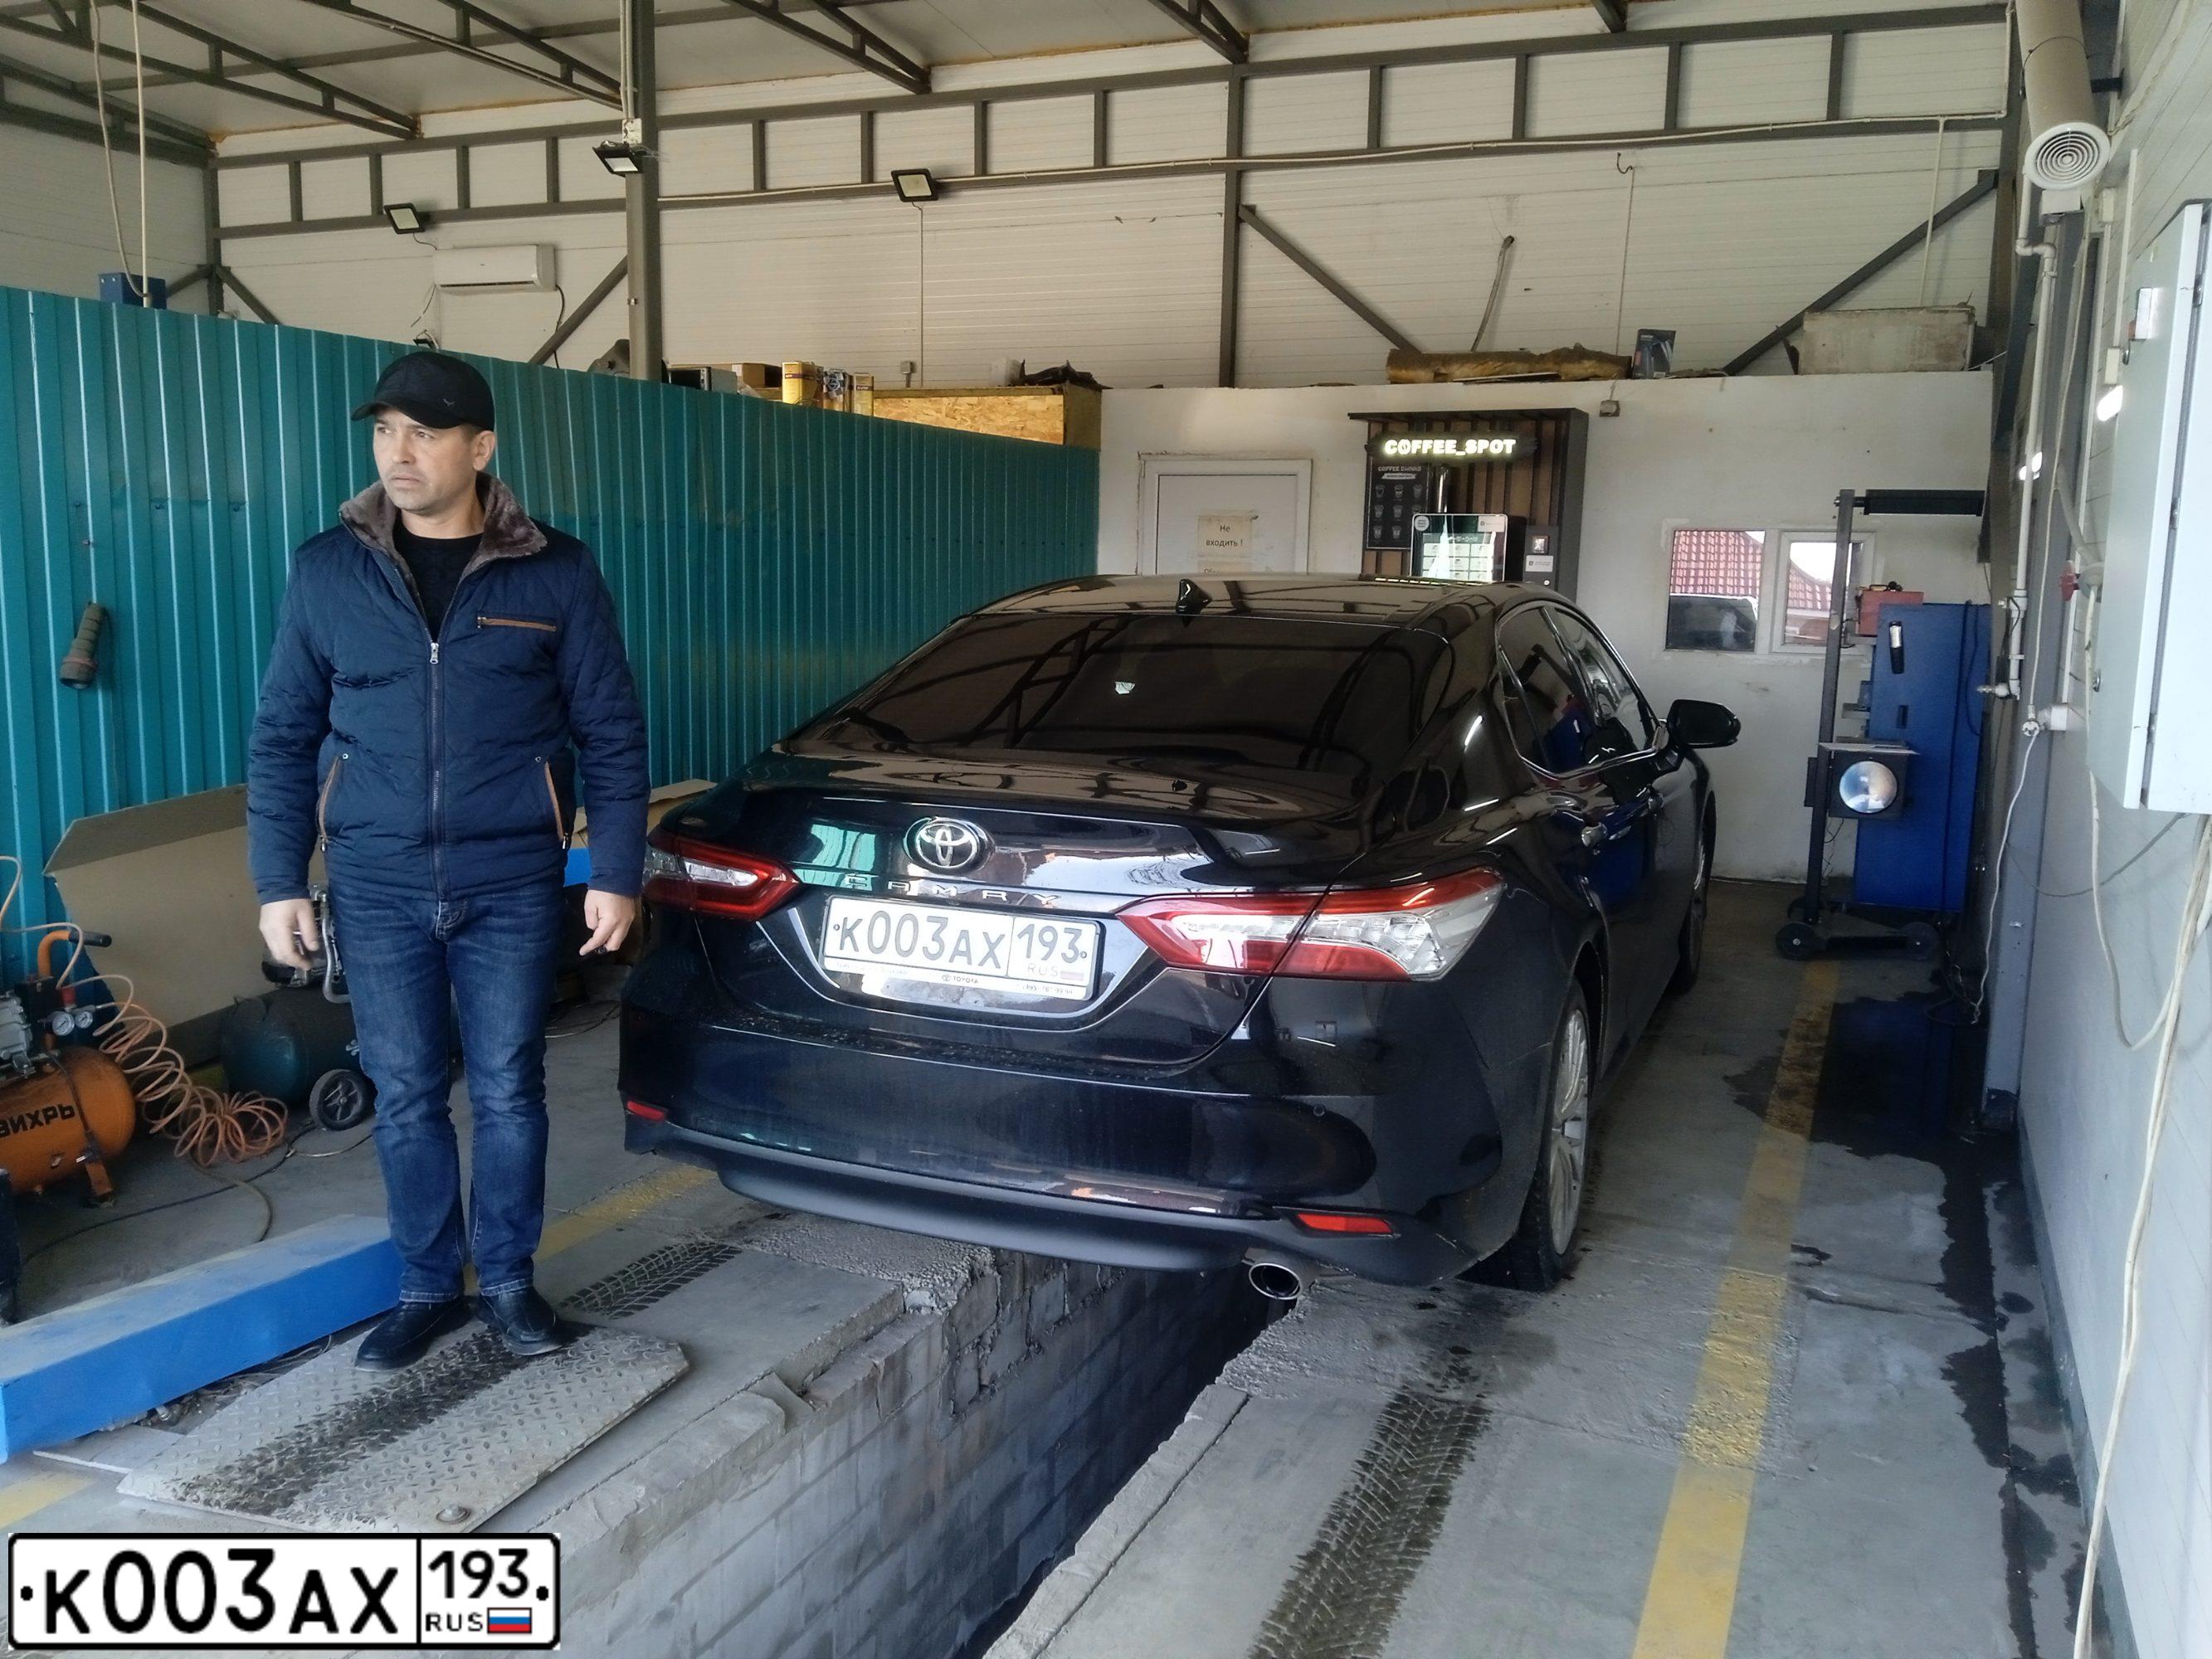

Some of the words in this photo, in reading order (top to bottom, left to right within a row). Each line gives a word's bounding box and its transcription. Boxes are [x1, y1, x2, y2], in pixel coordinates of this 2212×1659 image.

[1384, 439, 1517, 456] COFFEE_SPOT
[1220, 524, 1231, 533] Не
[1206, 539, 1238, 547] входить
[1016, 923, 1083, 964] 193
[1026, 962, 1059, 977] RUS
[953, 975, 979, 985] TOYOTA
[0, 1104, 76, 1138] ВИХРЬ
